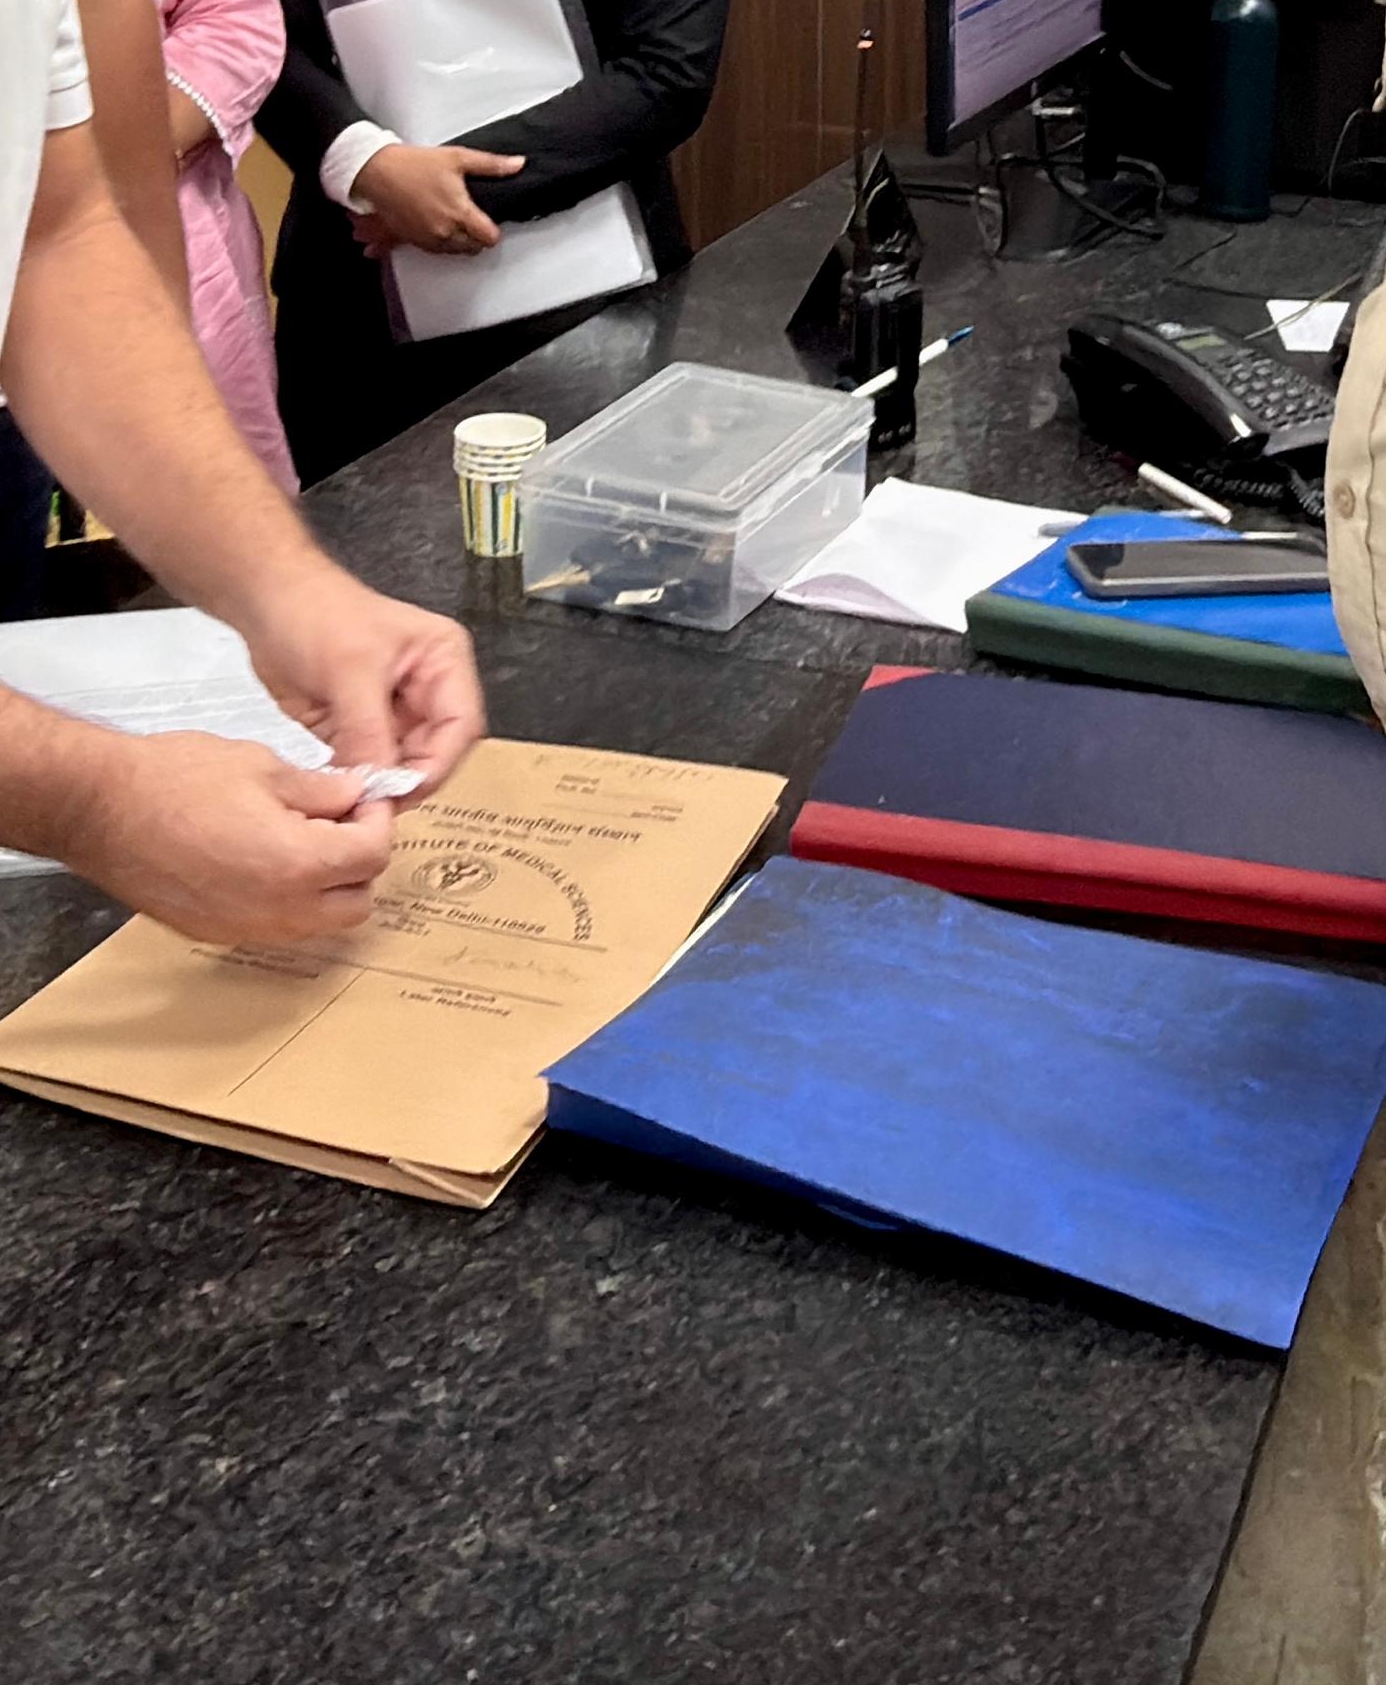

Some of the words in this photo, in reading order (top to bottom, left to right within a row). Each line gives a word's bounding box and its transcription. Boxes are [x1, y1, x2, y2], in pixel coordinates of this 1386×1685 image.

[473, 841, 497, 853] OF
[501, 848, 566, 884] MEDICAL
[410, 902, 443, 915] New
